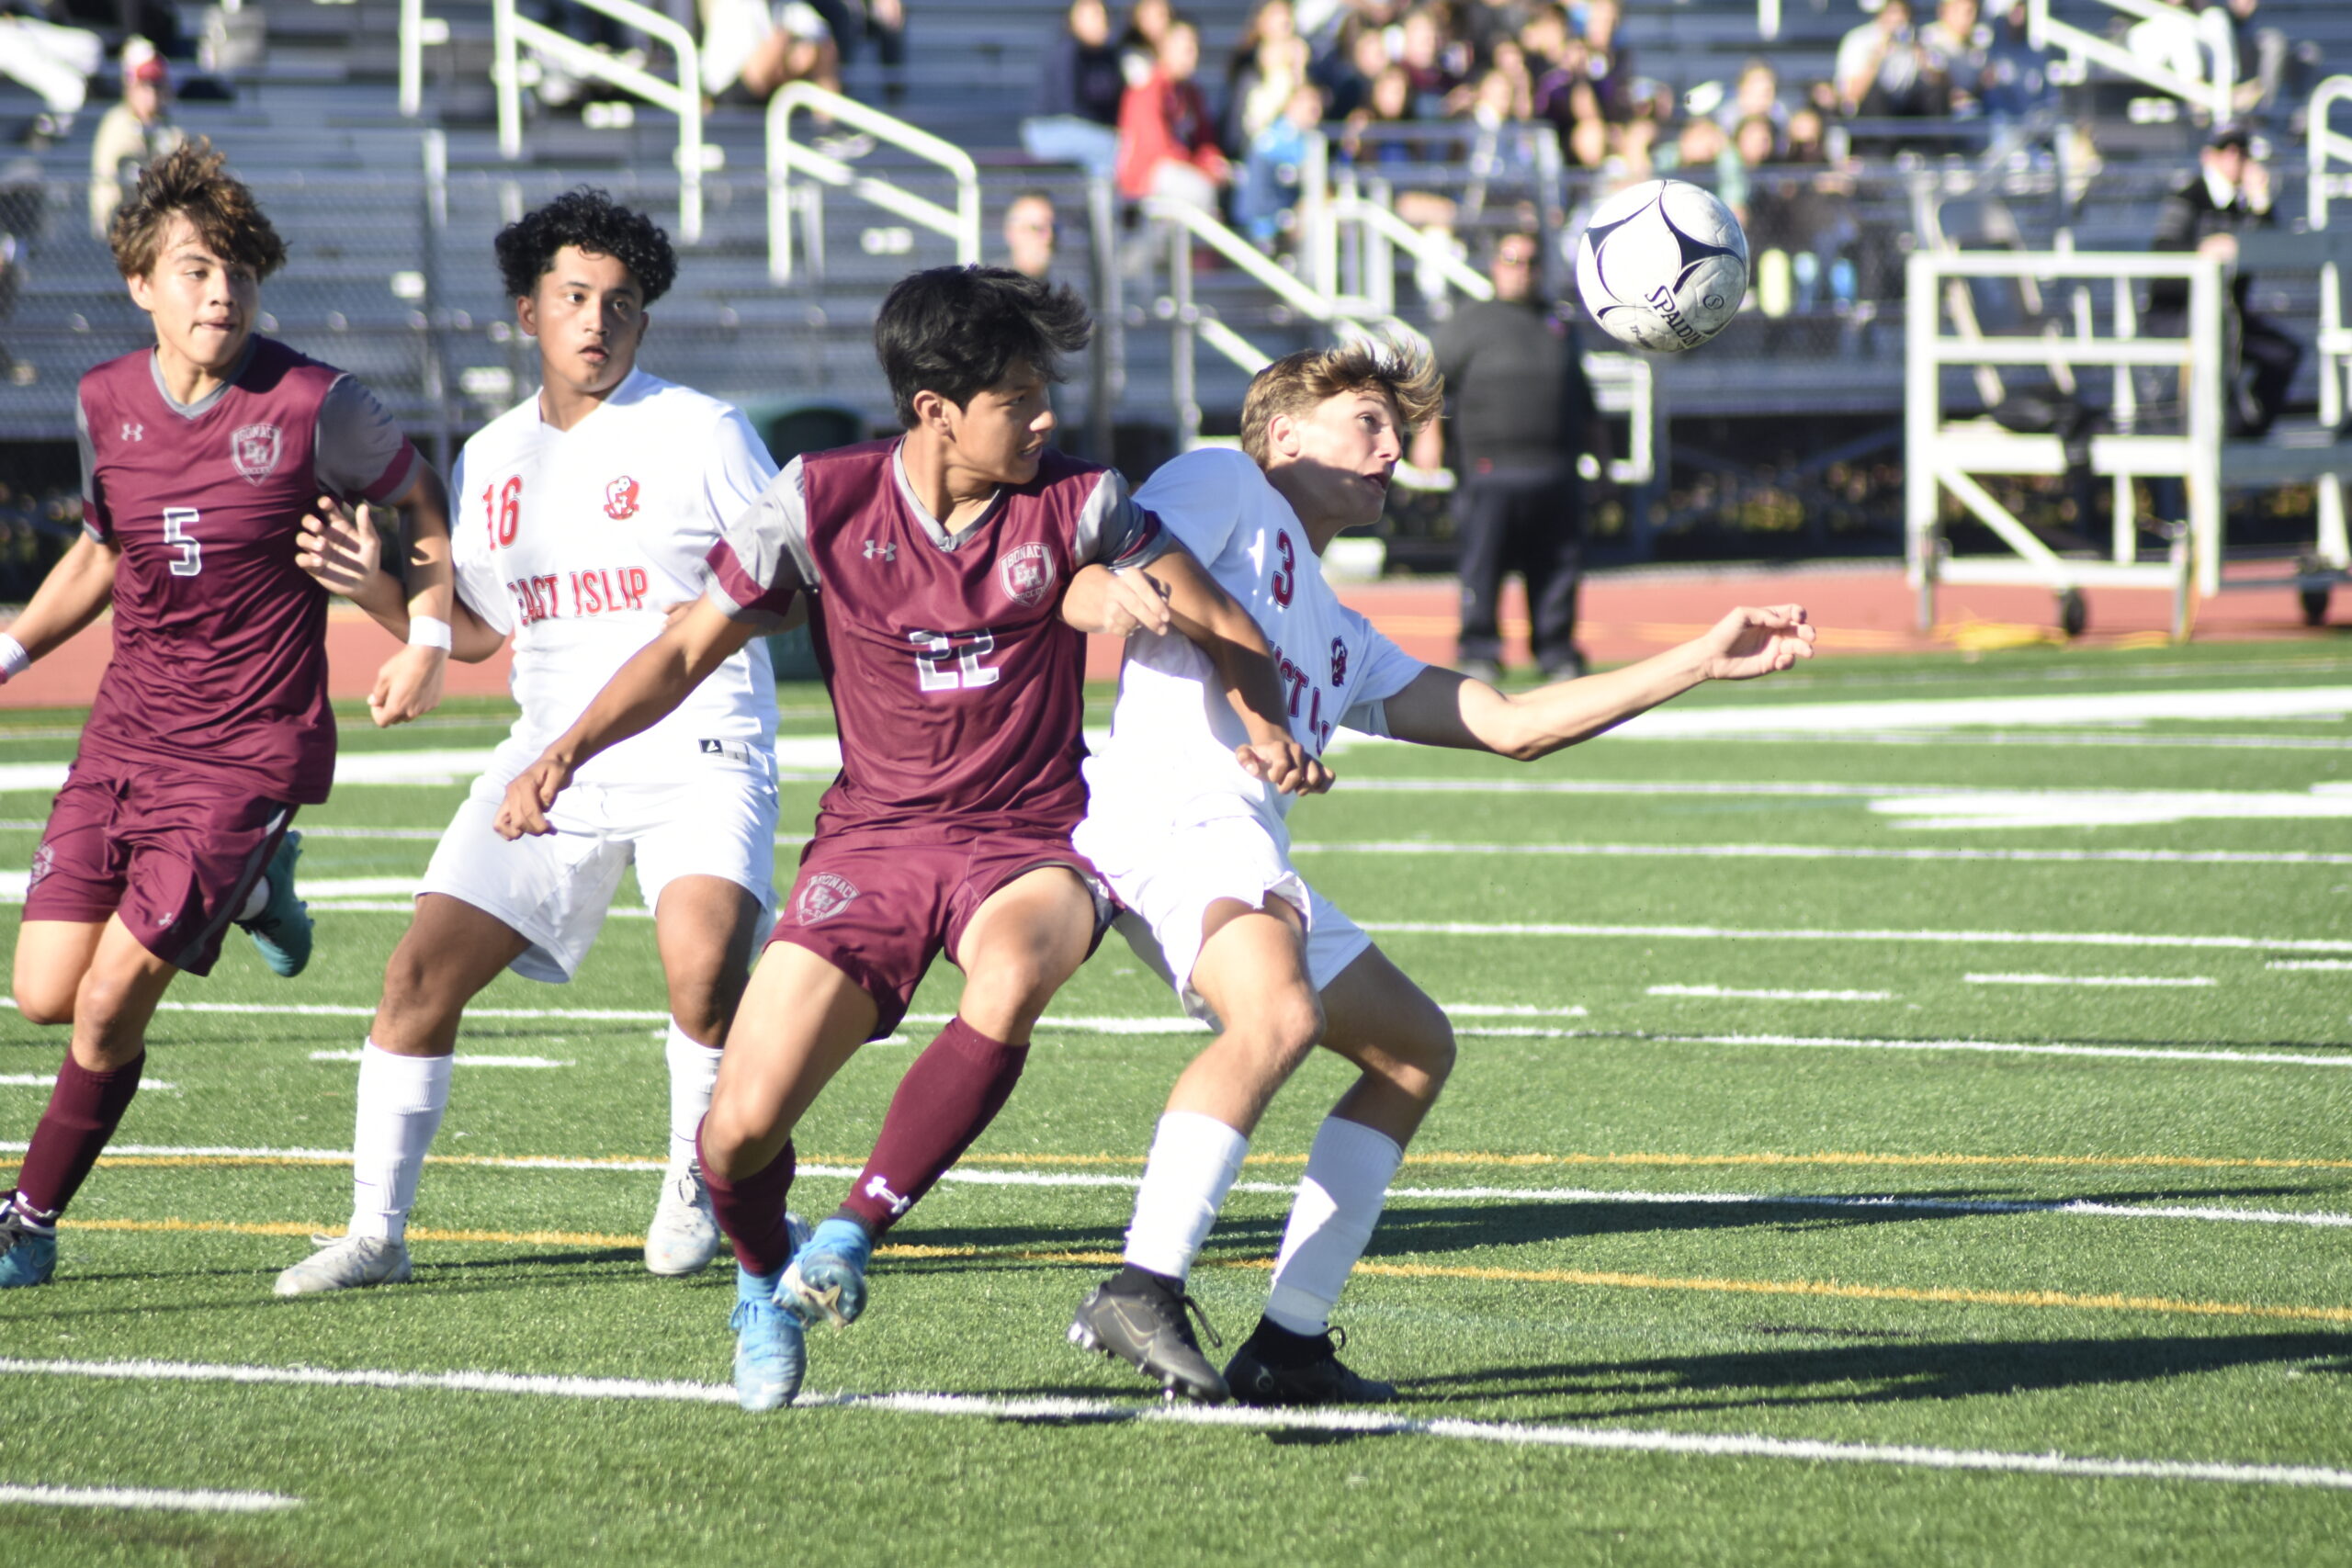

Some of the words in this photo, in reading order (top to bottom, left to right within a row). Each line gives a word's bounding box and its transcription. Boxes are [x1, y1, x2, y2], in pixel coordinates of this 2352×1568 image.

[163, 507, 202, 576] 5
[482, 474, 523, 551] 16
[1007, 544, 1043, 568] BONAC
[1272, 528, 1295, 609] 3
[570, 566, 649, 617] ISLIP
[909, 627, 1000, 692] 22
